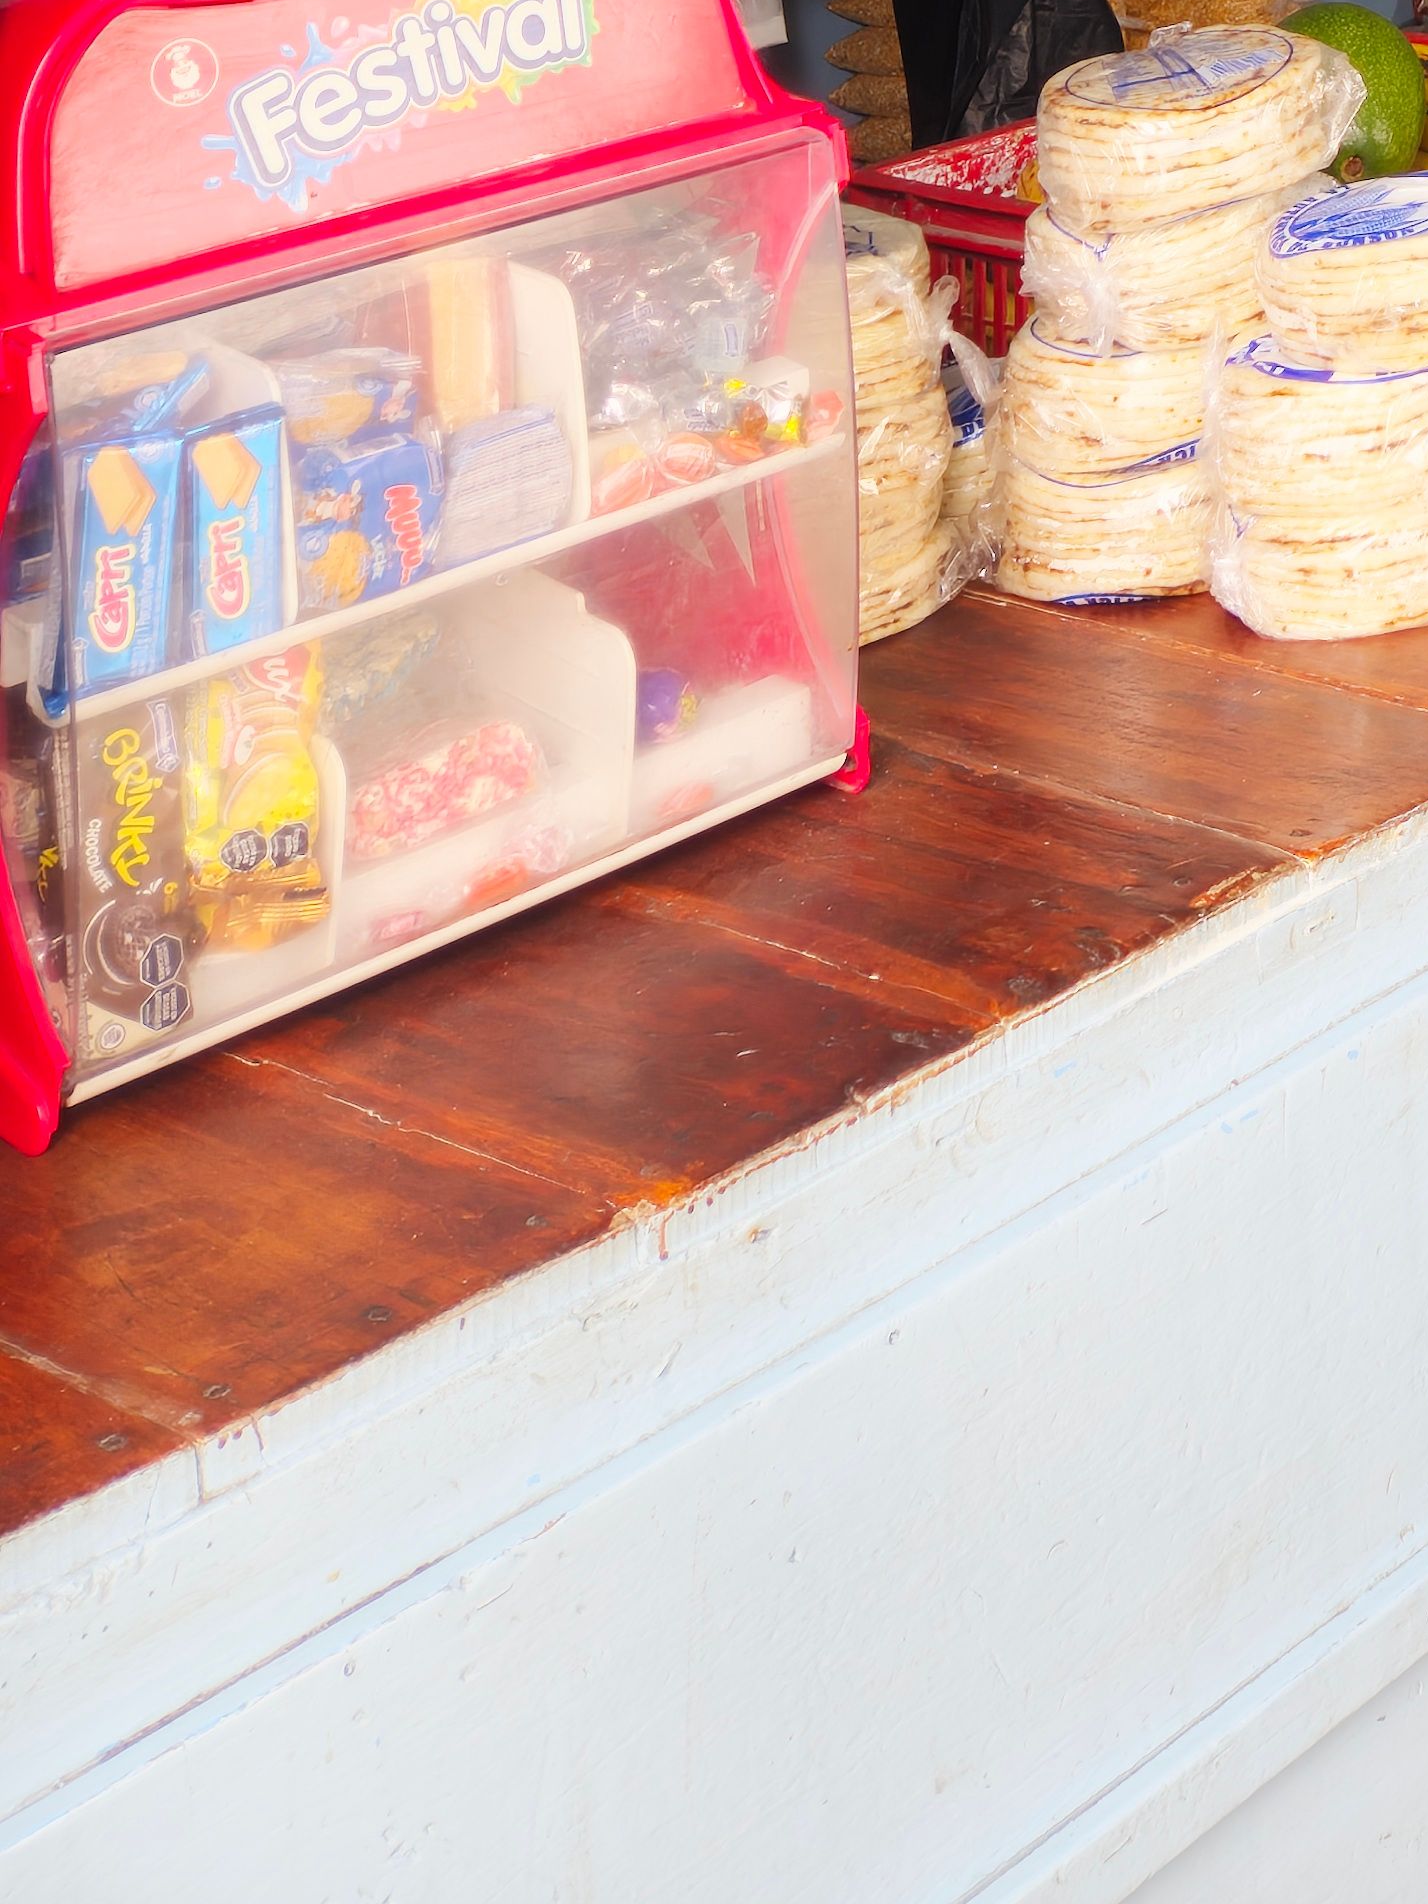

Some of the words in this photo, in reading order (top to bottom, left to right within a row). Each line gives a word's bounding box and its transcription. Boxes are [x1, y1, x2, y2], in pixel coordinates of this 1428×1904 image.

[90, 543, 135, 652] Capri
[206, 515, 245, 619] Capri
[90, 817, 114, 894] CHOCOLATE
[103, 728, 163, 888] BRINKY
